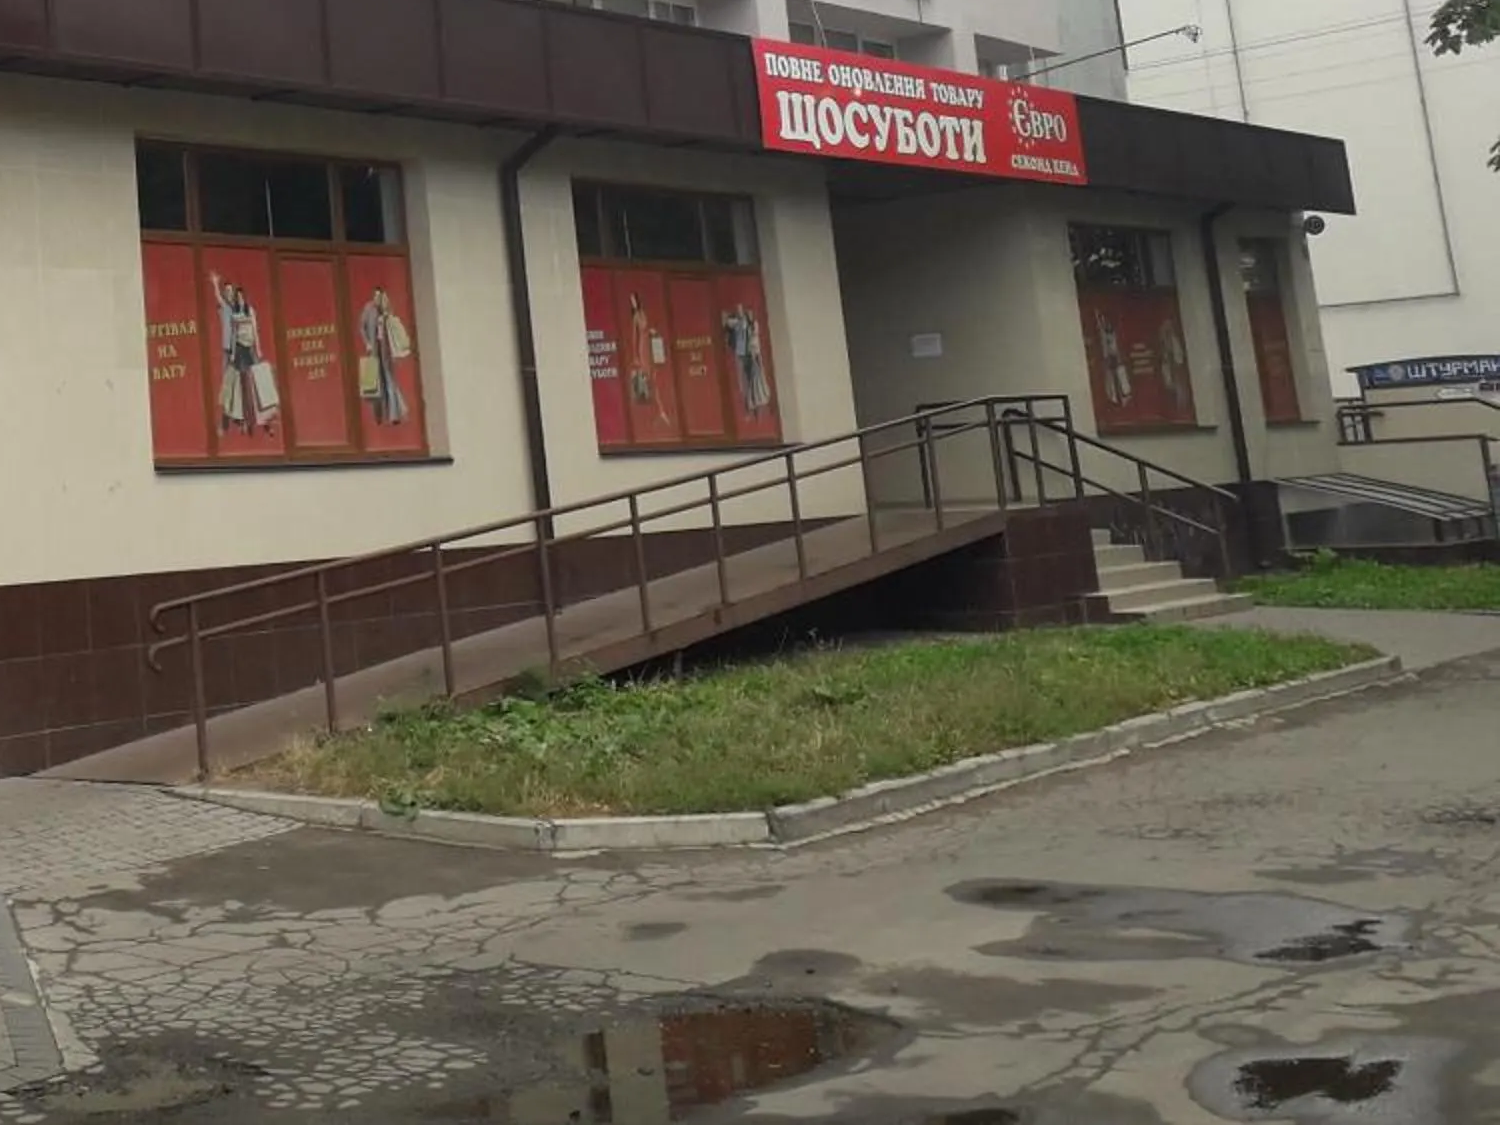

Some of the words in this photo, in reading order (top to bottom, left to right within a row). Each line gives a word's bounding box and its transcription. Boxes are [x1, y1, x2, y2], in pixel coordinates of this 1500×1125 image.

[764, 52, 825, 84] ПОВНЕ
[828, 63, 927, 101] ОНОВЛЕННЯ
[931, 82, 984, 110] ТОВАРУ
[775, 90, 988, 165] ЩОСУБОТИ
[1012, 98, 1068, 143] ЄВРО
